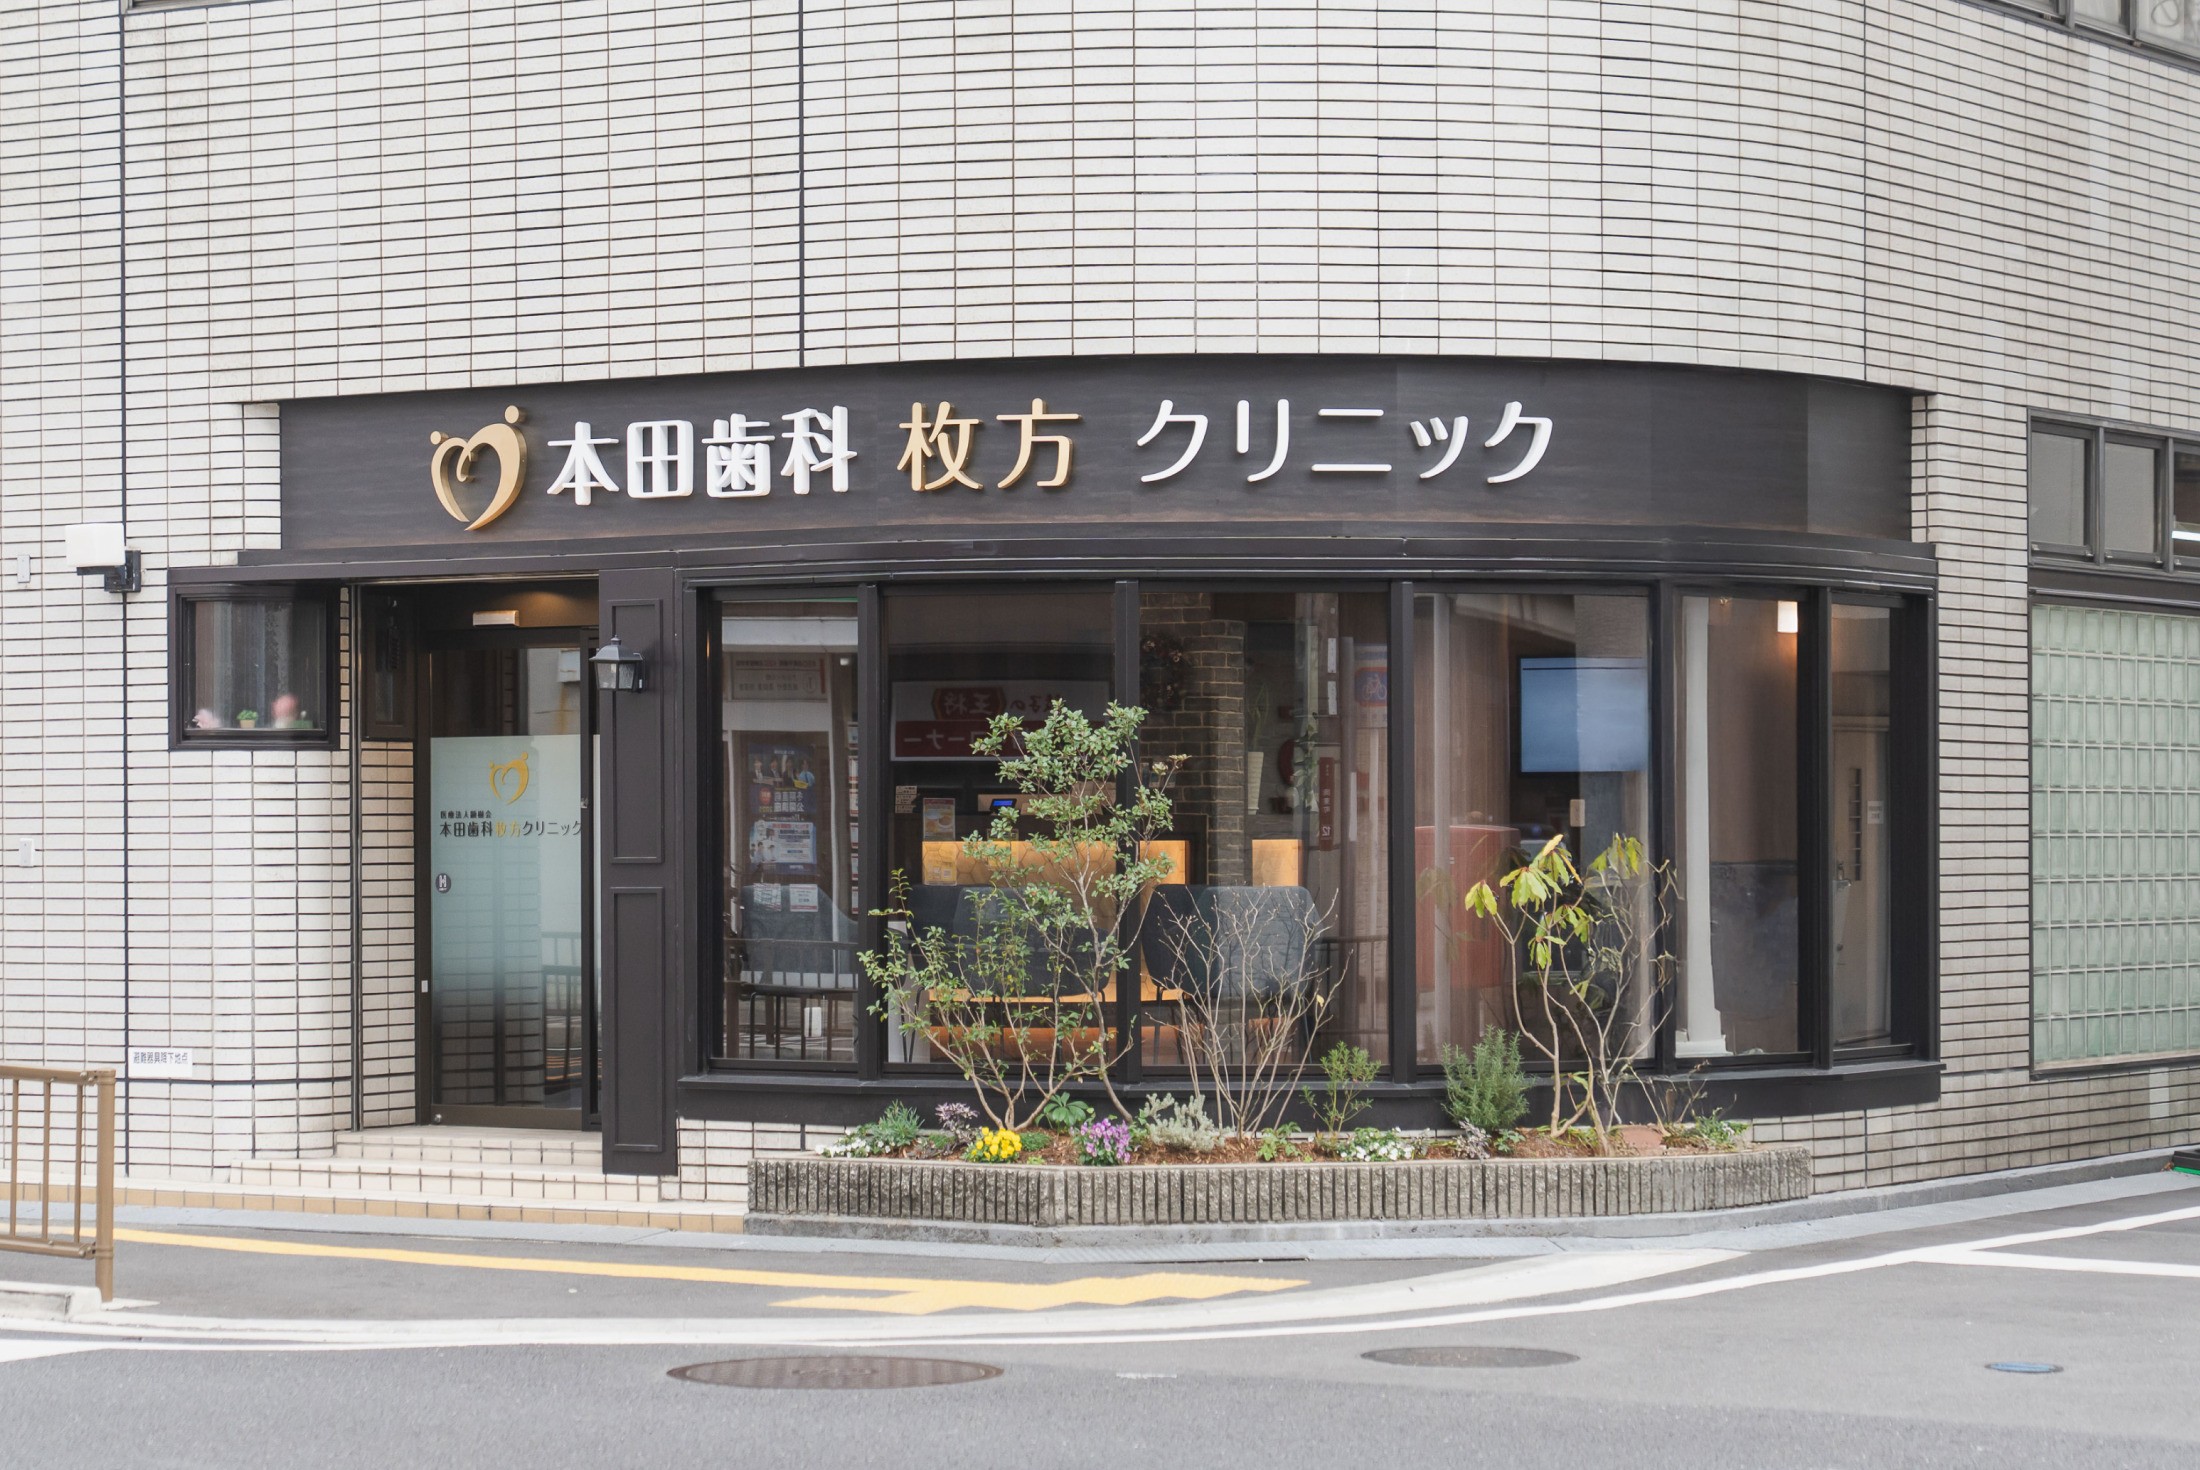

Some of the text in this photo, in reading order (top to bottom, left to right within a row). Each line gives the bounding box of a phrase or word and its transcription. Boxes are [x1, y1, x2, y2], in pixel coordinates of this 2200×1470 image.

[547, 398, 1554, 506] 本田歯科 枚方 クリニック
